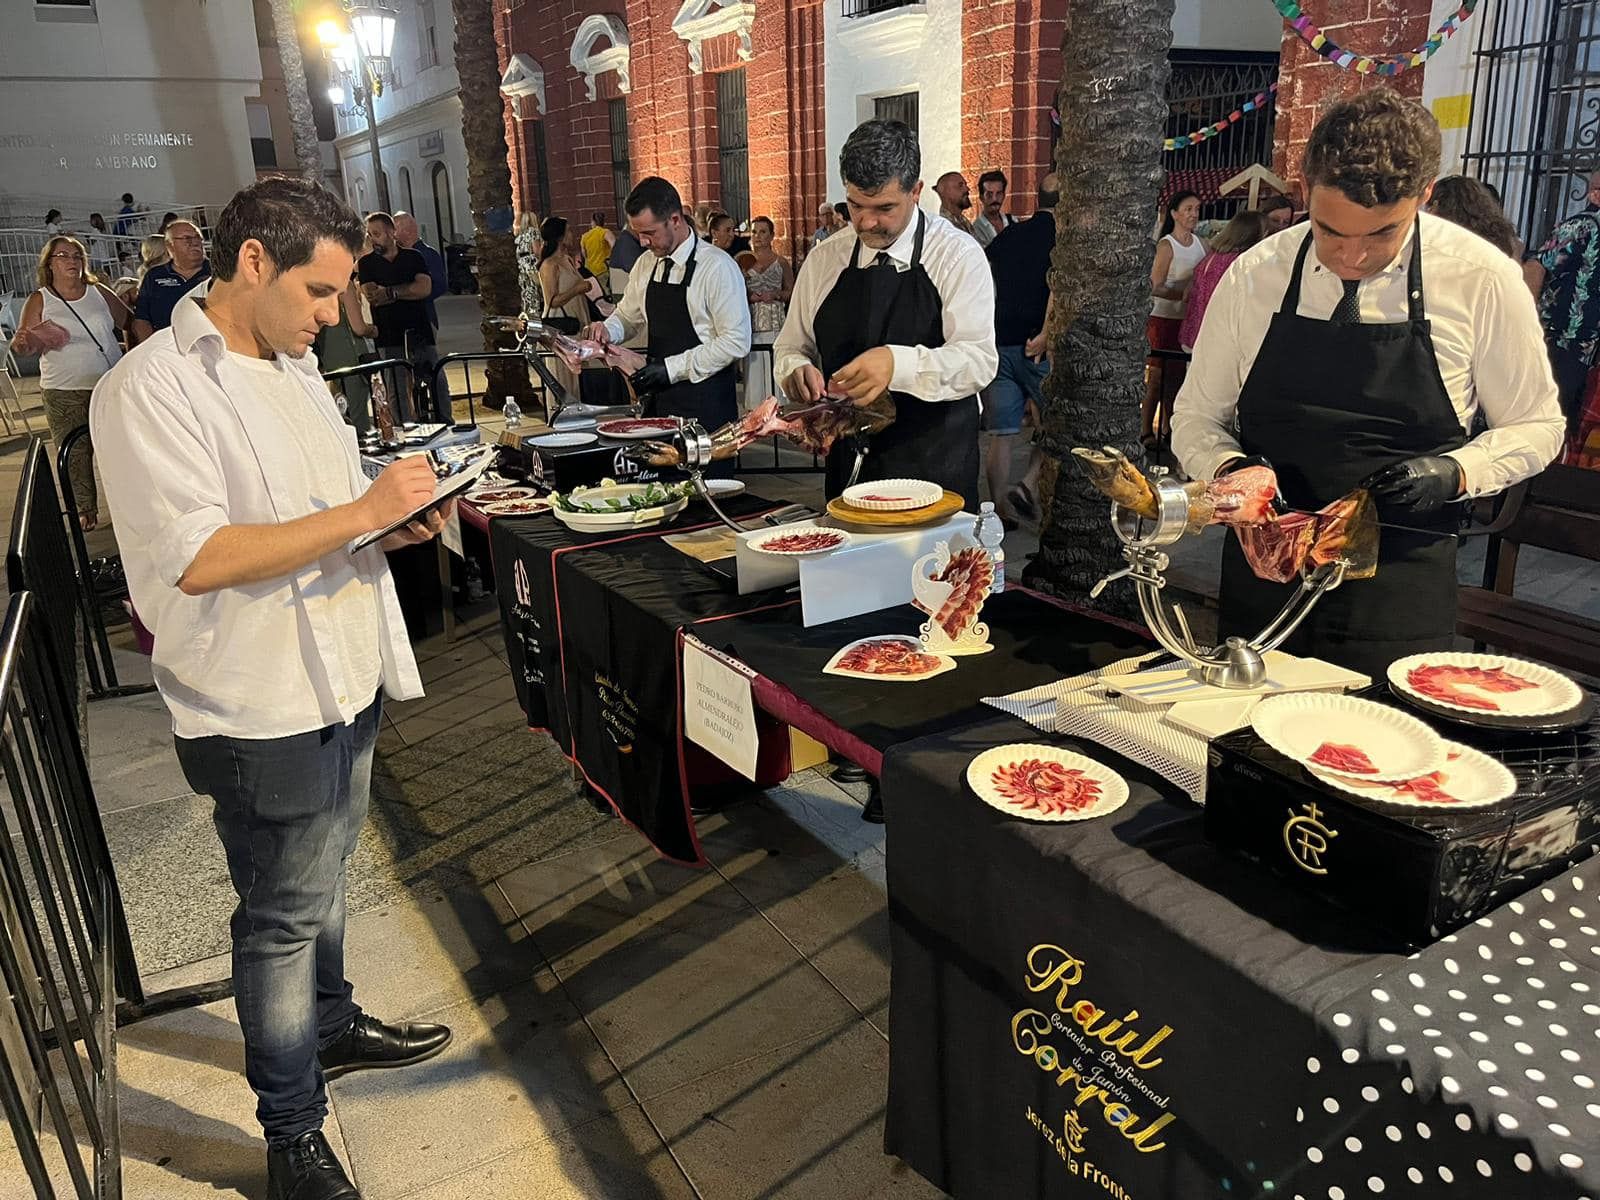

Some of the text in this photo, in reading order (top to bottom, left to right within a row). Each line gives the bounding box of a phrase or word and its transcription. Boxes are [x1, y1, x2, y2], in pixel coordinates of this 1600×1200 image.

[124, 132, 194, 147] PERMANENTE
[703, 717, 735, 744] (BADAJOZ)
[1024, 943, 1174, 1070] Raúl
[1050, 1012, 1095, 1056] Cortador
[1011, 1008, 1177, 1153] Corral
[1072, 1056, 1132, 1103] de Jamón
[1025, 1105, 1055, 1145] Jerez
[1055, 1137, 1068, 1161] de
[1067, 1150, 1079, 1176] la
